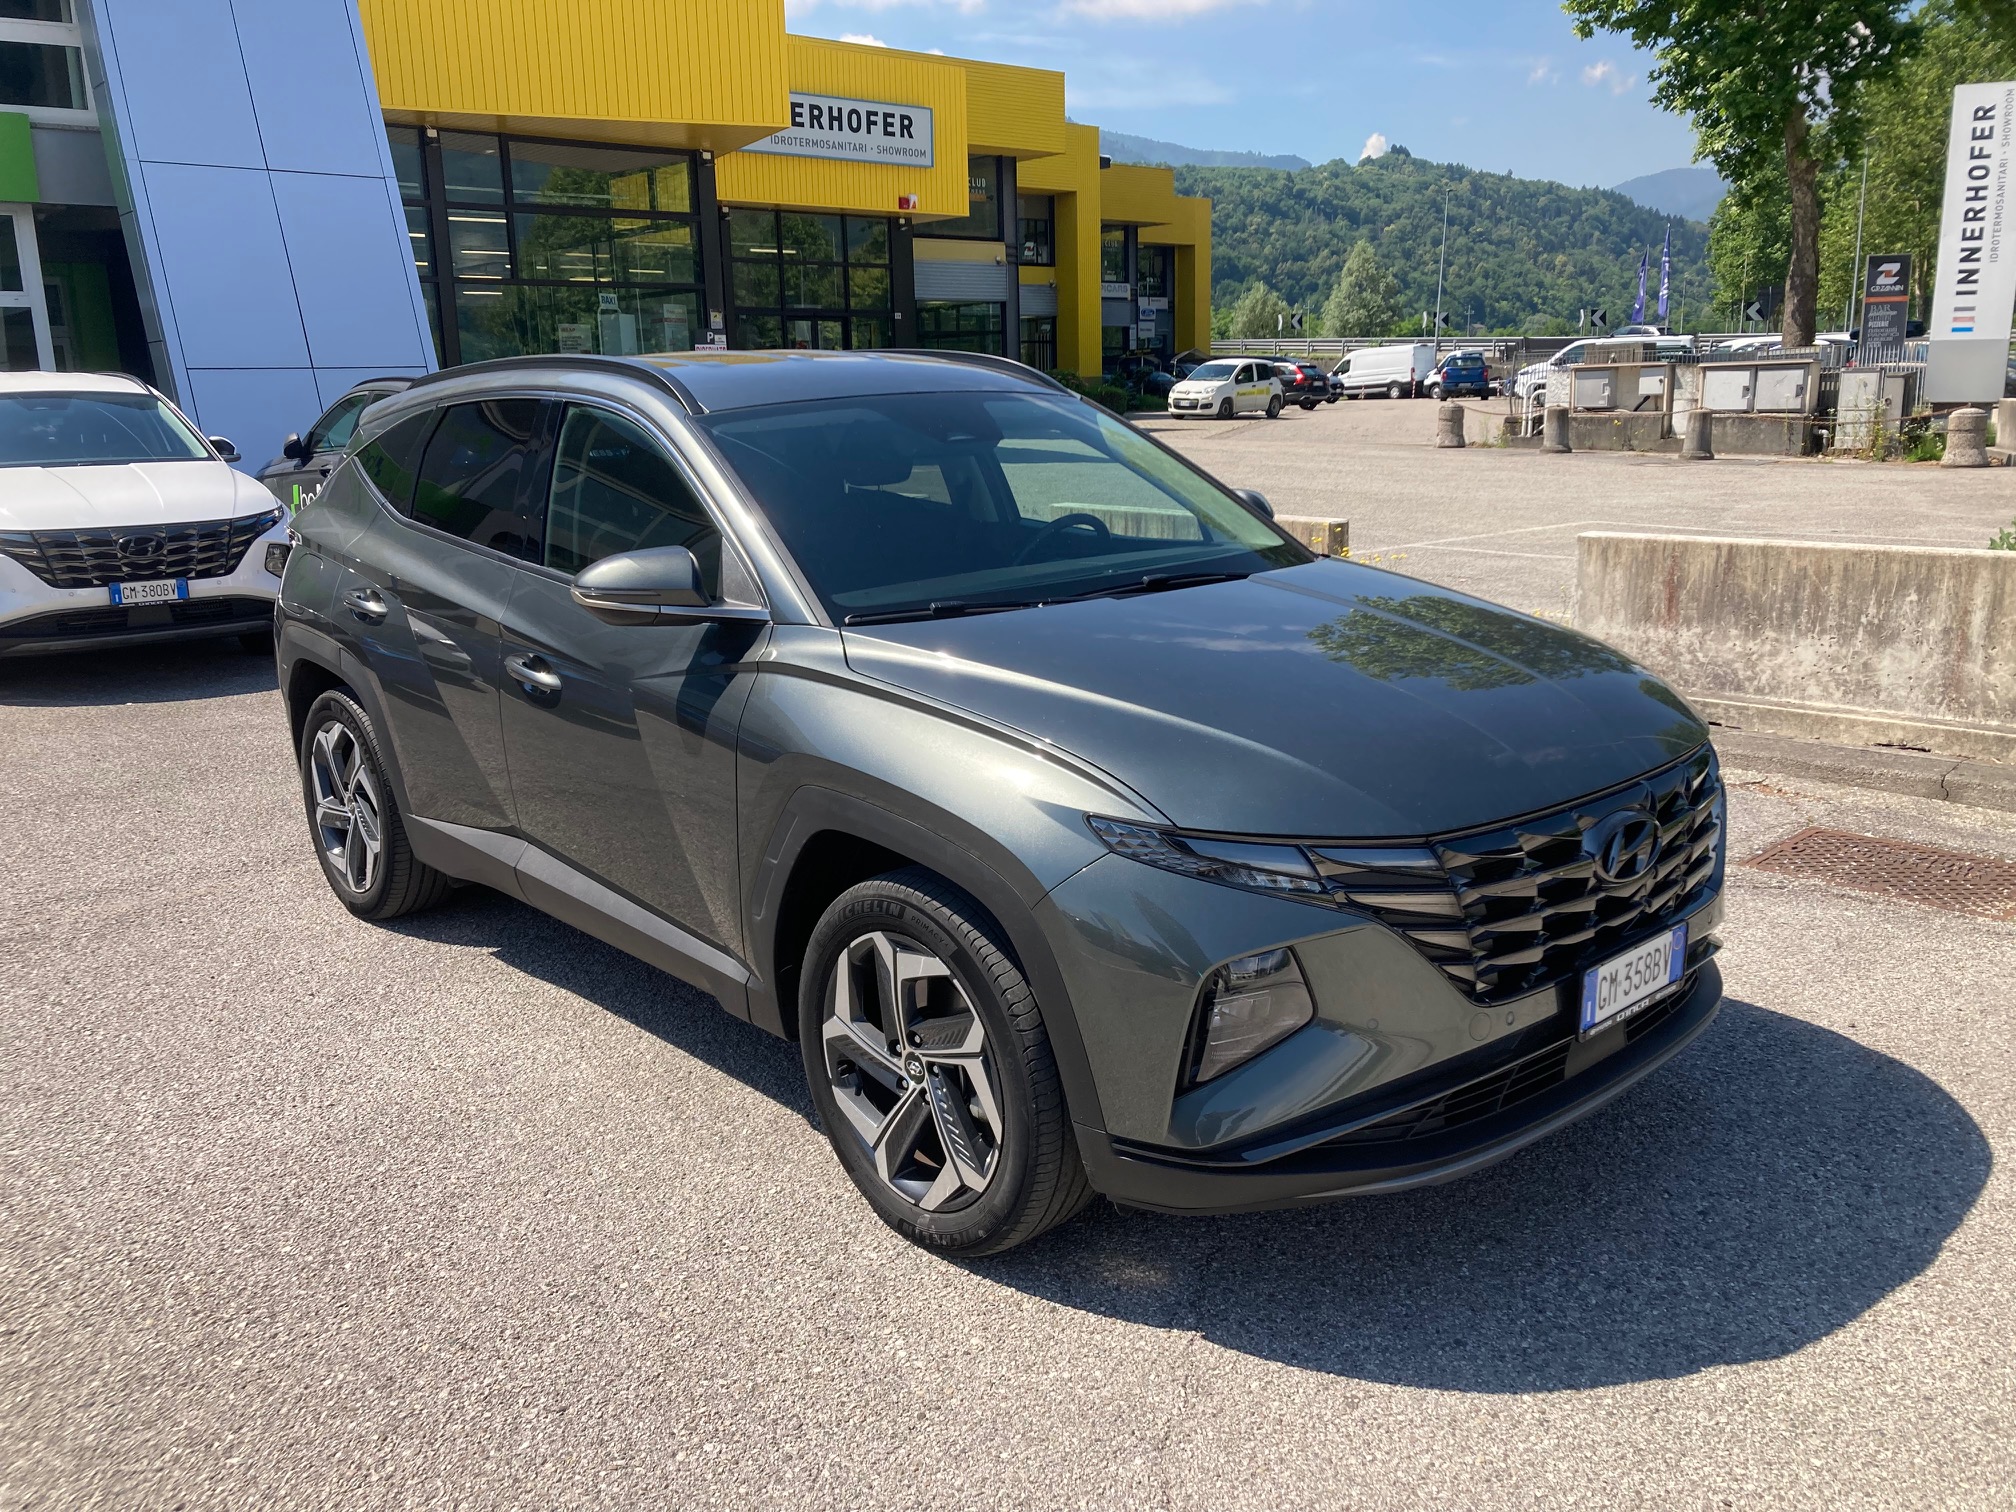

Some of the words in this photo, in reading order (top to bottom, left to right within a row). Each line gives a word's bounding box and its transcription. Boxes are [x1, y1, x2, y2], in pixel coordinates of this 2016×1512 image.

[790, 101, 914, 139] ERHOFER
[770, 134, 867, 153] IDROTERMOSANITARI
[876, 145, 927, 159] SHOWROOM
[1990, 157, 2008, 263] IDROTERMOSANITARI
[2001, 88, 2015, 147] SHOWROOM
[1955, 103, 1997, 296] INNERHOFER
[601, 295, 616, 305] BAXI
[1870, 304, 1891, 312] BAR
[707, 331, 714, 343] P
[910, 915, 944, 944] PRIMACY
